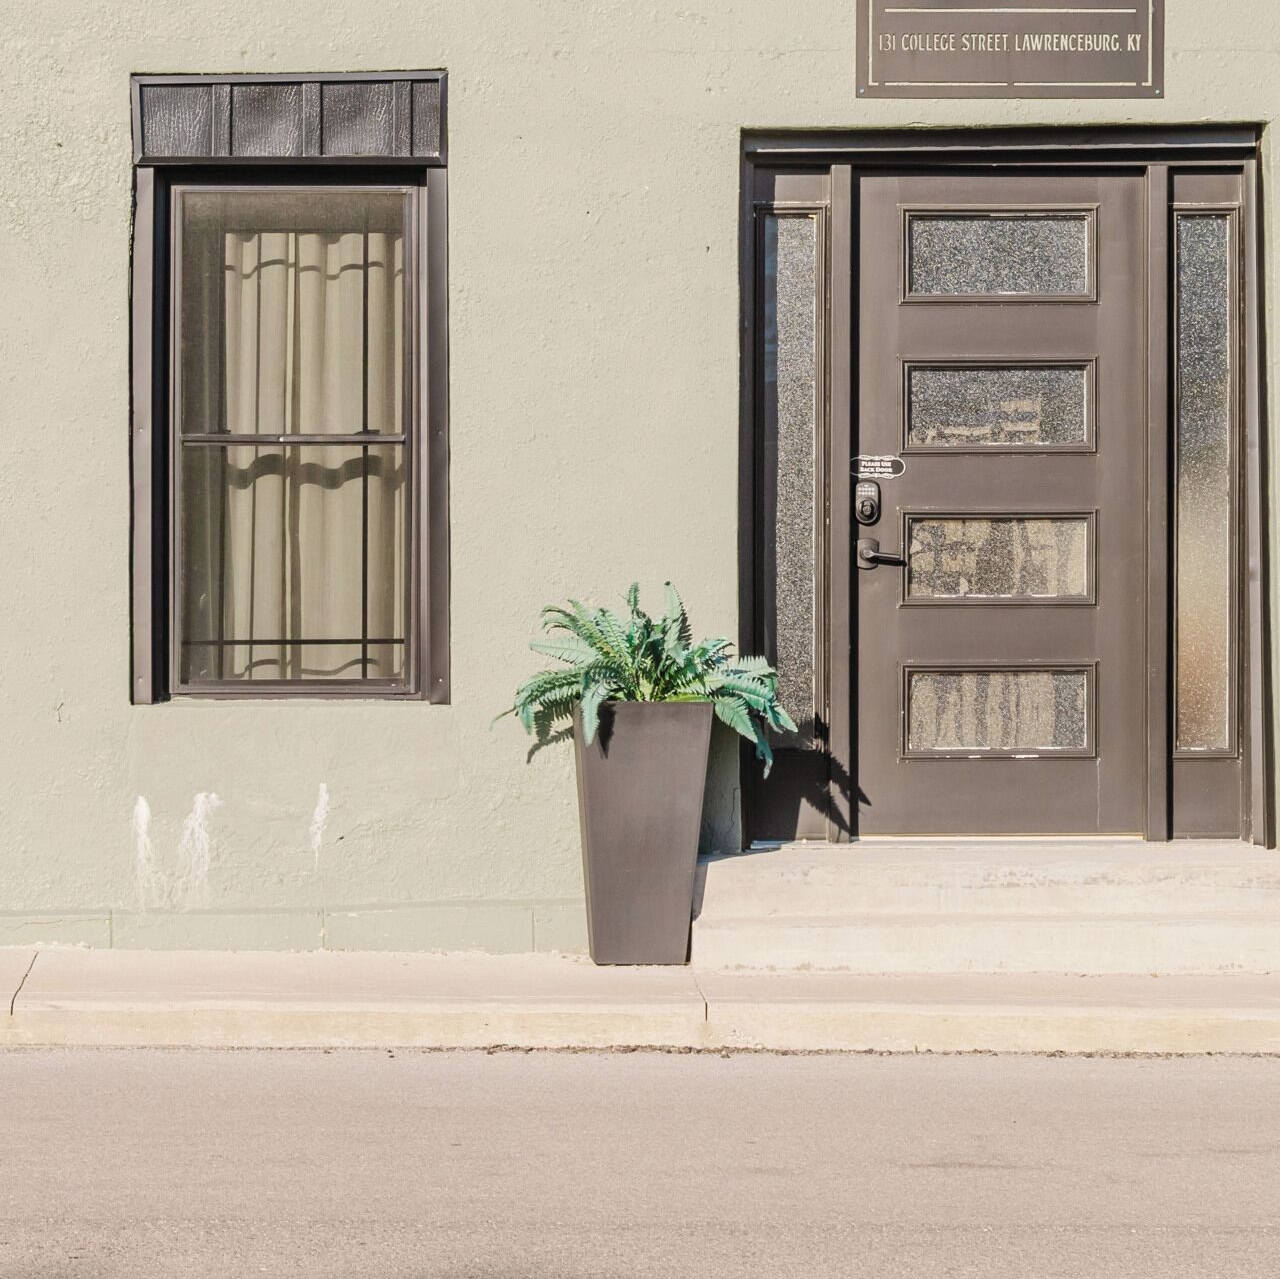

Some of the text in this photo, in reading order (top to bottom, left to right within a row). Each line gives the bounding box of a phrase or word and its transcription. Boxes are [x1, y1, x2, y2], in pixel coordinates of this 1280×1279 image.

[879, 34, 896, 51] 131
[901, 34, 956, 51] COLLEGE
[1127, 34, 1141, 51] KY
